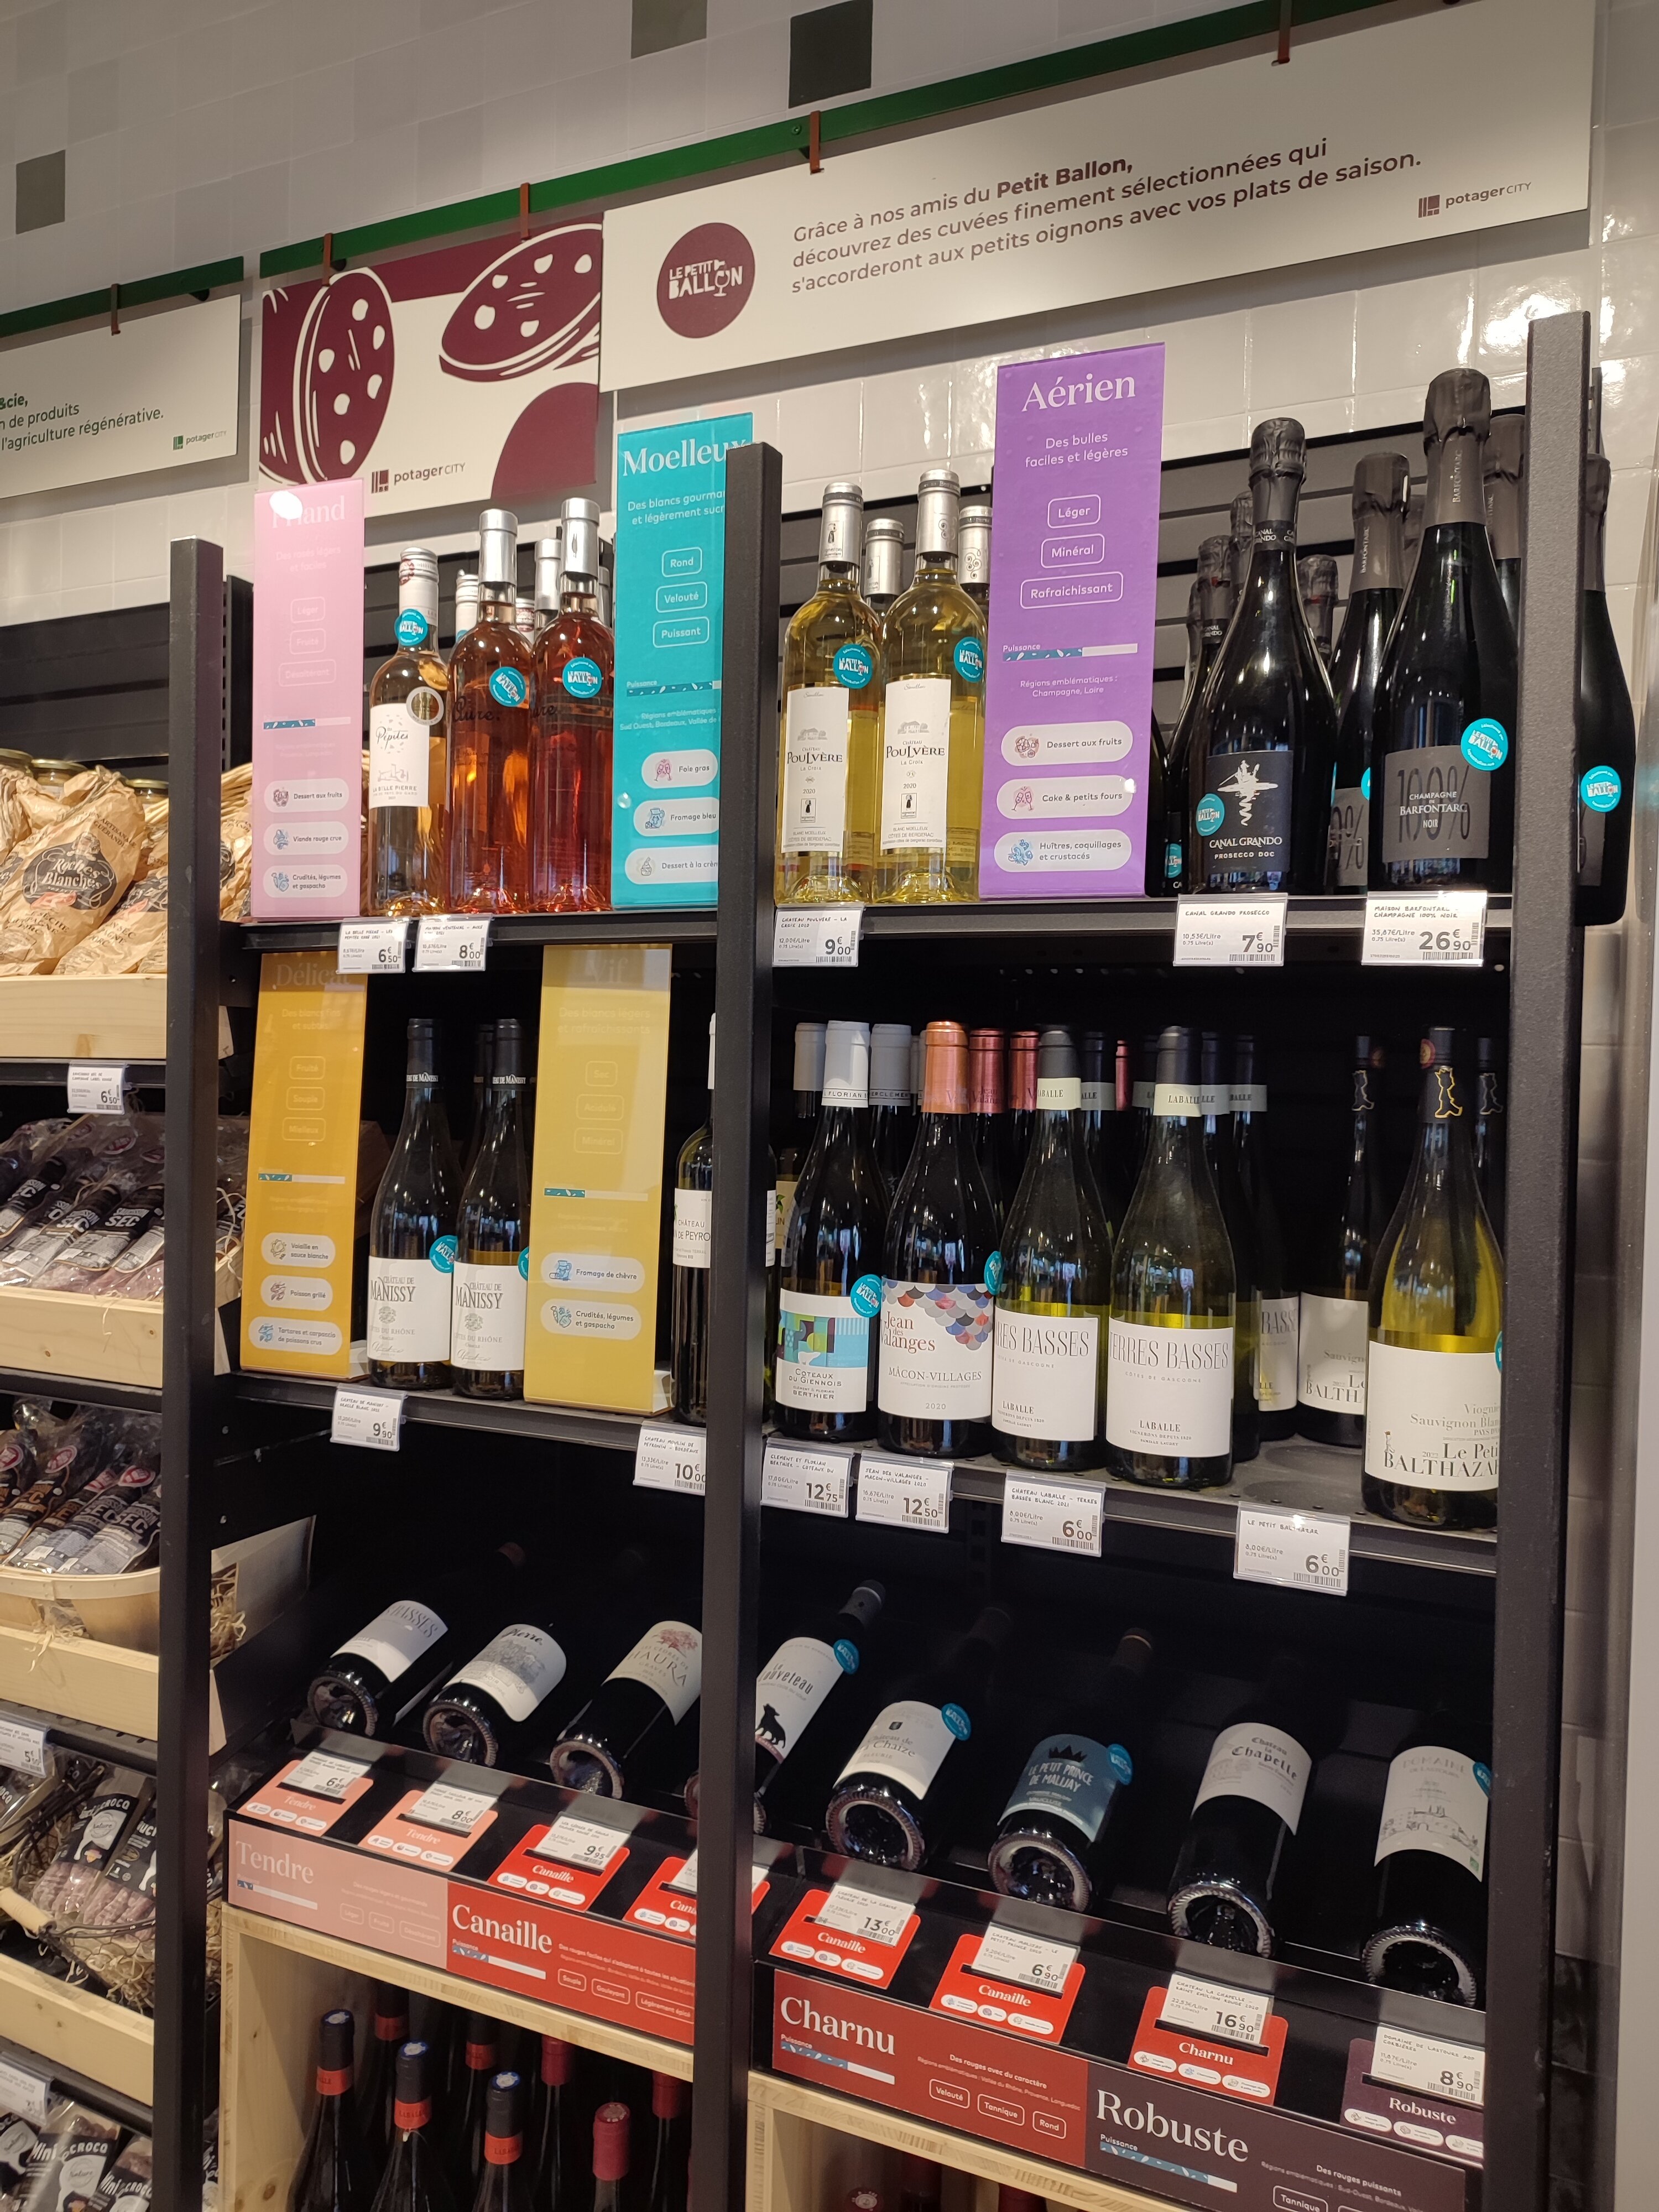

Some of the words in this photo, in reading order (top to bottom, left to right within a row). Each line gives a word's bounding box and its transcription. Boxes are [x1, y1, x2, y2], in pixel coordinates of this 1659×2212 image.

[793, 235, 891, 268] découvrez
[896, 224, 932, 247] des
[937, 210, 1009, 238] cuvées
[1014, 185, 1116, 220] finement
[1121, 152, 1281, 200] sélectionnées
[1288, 138, 1327, 165] qui
[794, 220, 847, 244] Grâce
[853, 212, 864, 230] à
[870, 206, 905, 226] nos
[910, 193, 958, 217] amis
[963, 185, 990, 206] du
[997, 174, 1049, 199] Petit
[1056, 155, 1133, 187] Ballon,
[792, 253, 924, 294] s'accorderont
[928, 247, 965, 266] aux
[970, 230, 1030, 262] petits
[1035, 210, 1123, 247] oignons
[1129, 199, 1181, 225] avec
[1187, 191, 1225, 212] vos
[1232, 178, 1291, 208] plats
[1298, 168, 1328, 190] de
[1334, 150, 1421, 182] saison.
[669, 267, 683, 280] LE
[684, 260, 713, 277] PETIT
[669, 264, 743, 300] BALLON
[1021, 373, 1136, 412] Aérien
[9, 416, 24, 429] de
[28, 403, 79, 427] produits
[2, 427, 75, 451] l'agriculture
[79, 408, 164, 436] régénérative.
[1046, 438, 1068, 448] Des
[1073, 433, 1108, 446] bulles
[1025, 455, 1063, 467] faciles
[1067, 453, 1079, 461] et
[1083, 448, 1128, 462] légères
[628, 500, 646, 512] Des
[649, 497, 681, 509] blancs
[632, 516, 643, 525] et
[645, 508, 701, 524] légèrement
[1058, 507, 1091, 519] Léger
[1051, 545, 1094, 558] Minéral
[670, 557, 693, 568] Rond
[664, 592, 699, 604] Velouté
[661, 627, 701, 638] Puissant
[1003, 643, 1040, 651] Puissance
[627, 680, 658, 688] Puissance
[1020, 679, 1050, 688] Régions
[1052, 675, 1112, 686] emblématiques
[1032, 688, 1082, 698] Champagne,
[1047, 739, 1079, 749] Dessert
[1098, 737, 1122, 745] fruits
[1073, 793, 1098, 802] petits
[1100, 792, 1123, 800] fours
[1409, 791, 1457, 800] CHAMPAGNE
[671, 813, 701, 822] Fromage
[1399, 804, 1467, 816] BARFONTARC
[1423, 820, 1438, 828] NOIR
[1040, 841, 1072, 851] Huîtres,
[1074, 841, 1121, 851] coquillages
[1209, 838, 1238, 849] CANAL
[1239, 836, 1282, 848] GRANDO
[1050, 852, 1090, 860] crustacés
[53, 858, 101, 878] Roches
[43, 871, 103, 889] Blanches
[678, 1219, 705, 1228] CHÂTEAU
[678, 1231, 684, 1239] DE
[383, 1276, 405, 1284] CHÂTEAU
[576, 1269, 604, 1277] Fromage
[615, 1272, 637, 1280] chèvre
[371, 1277, 415, 1303] MANISSY
[455, 1283, 503, 1310] MANISSY
[576, 1310, 605, 1319] Crudités,
[607, 1313, 634, 1322] légumes
[885, 1311, 914, 1330] Jean
[893, 1328, 904, 1336] des
[1022, 1328, 1089, 1357] BASSES
[1110, 1332, 1159, 1366] TERRES
[1167, 1342, 1228, 1369] BASSES
[795, 1369, 833, 1379] COTEAUX
[889, 1366, 982, 1381] MÂCON-VILLAGES
[800, 1376, 842, 1387] GIENNOIS
[793, 1390, 834, 1400] BERTHIER
[1003, 1401, 1034, 1415] LABALLE
[1140, 1420, 1180, 1432] LABALLE
[1410, 1414, 1477, 1430] Sauvignon
[1443, 1443, 1467, 1459] Le
[236, 1840, 314, 1884] Tendre
[532, 1864, 574, 1883] Canaille
[452, 1904, 552, 1954] Canaille
[817, 1931, 866, 1954] Canaille
[978, 1984, 1031, 2007] Canaille
[780, 1996, 896, 2056] Charnu
[1178, 2041, 1234, 2066] Charnu
[950, 2054, 963, 2064] Des
[963, 2058, 985, 2073] rouges
[988, 2068, 1003, 2077] avec
[1004, 2071, 1013, 2079] du
[1014, 2074, 1047, 2089] caractère
[936, 2086, 963, 2101] Velouté
[984, 2101, 1018, 2119] Tannique
[1040, 2119, 1060, 2131] Rond
[1389, 2096, 1457, 2125] Robuste
[1096, 2089, 1249, 2162] Robuste
[1100, 2133, 1138, 2151] Puissance
[1316, 2164, 1332, 2176] Des
[1333, 2170, 1360, 2184] rouges
[1363, 2179, 1402, 2197] puissants
